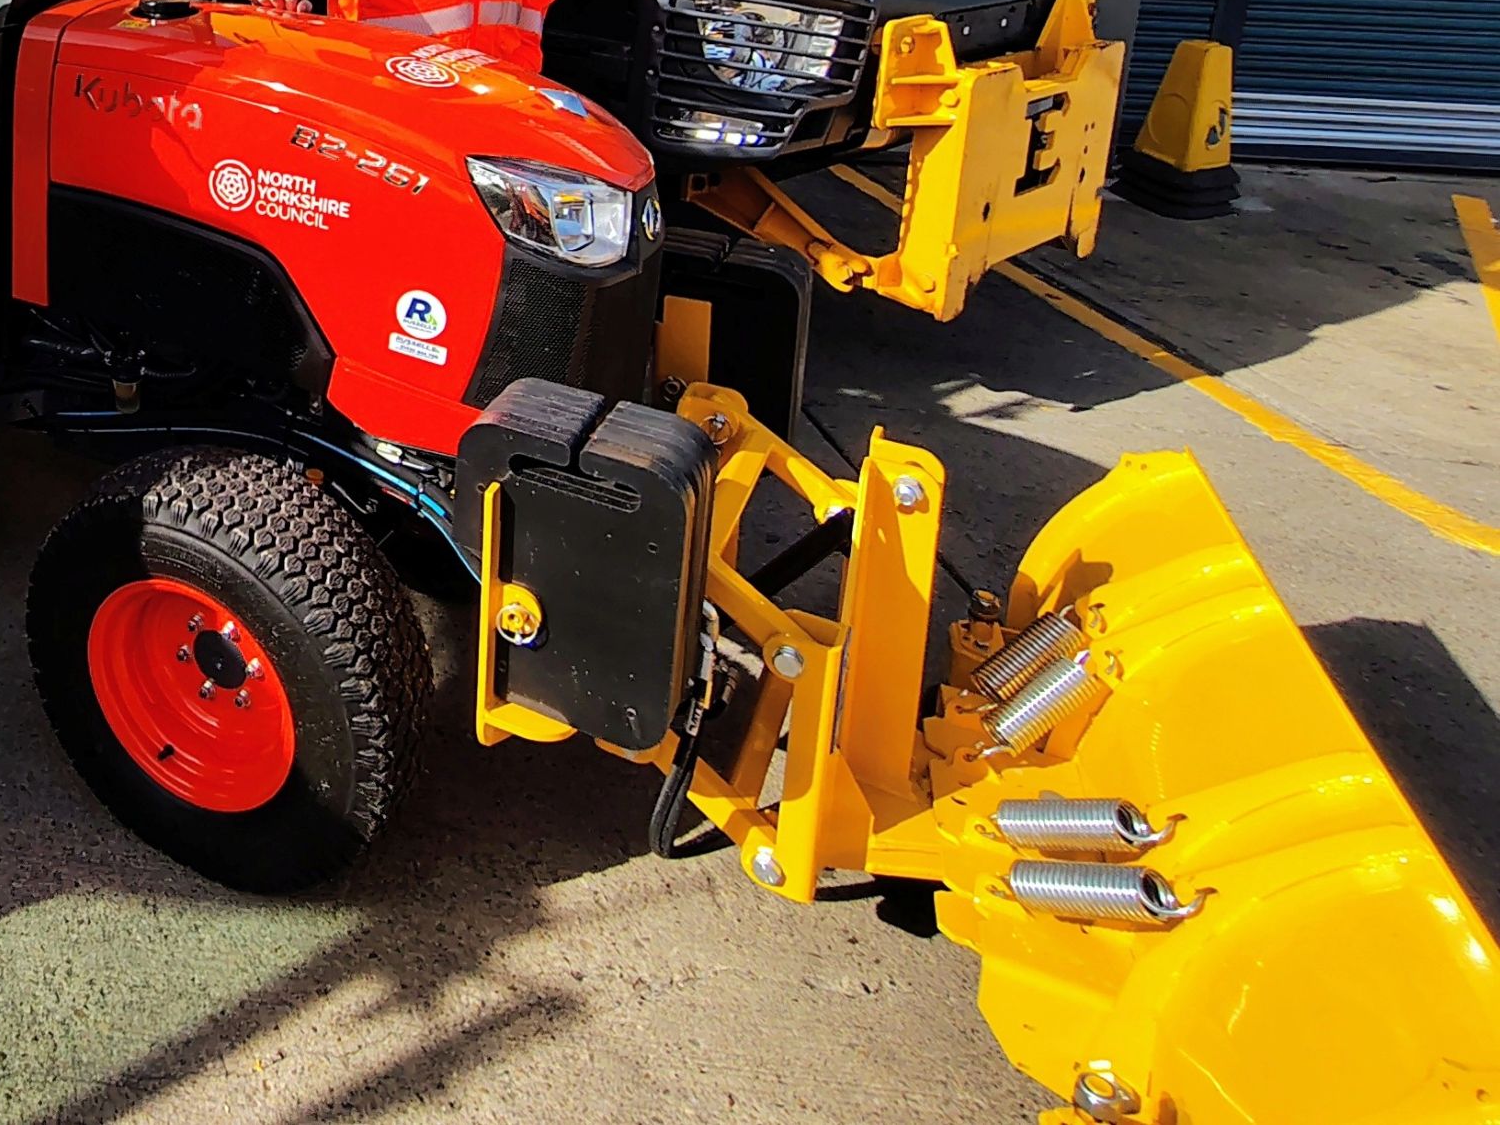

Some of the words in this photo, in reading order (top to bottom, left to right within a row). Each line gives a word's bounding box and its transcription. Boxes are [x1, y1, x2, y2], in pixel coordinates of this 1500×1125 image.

[74, 72, 203, 130] Kubota
[290, 123, 430, 195] B2-261
[257, 168, 316, 195] NORTH
[254, 199, 330, 230] COUNCIL
[257, 185, 351, 219] YORKSHIRE
[404, 297, 432, 323] R
